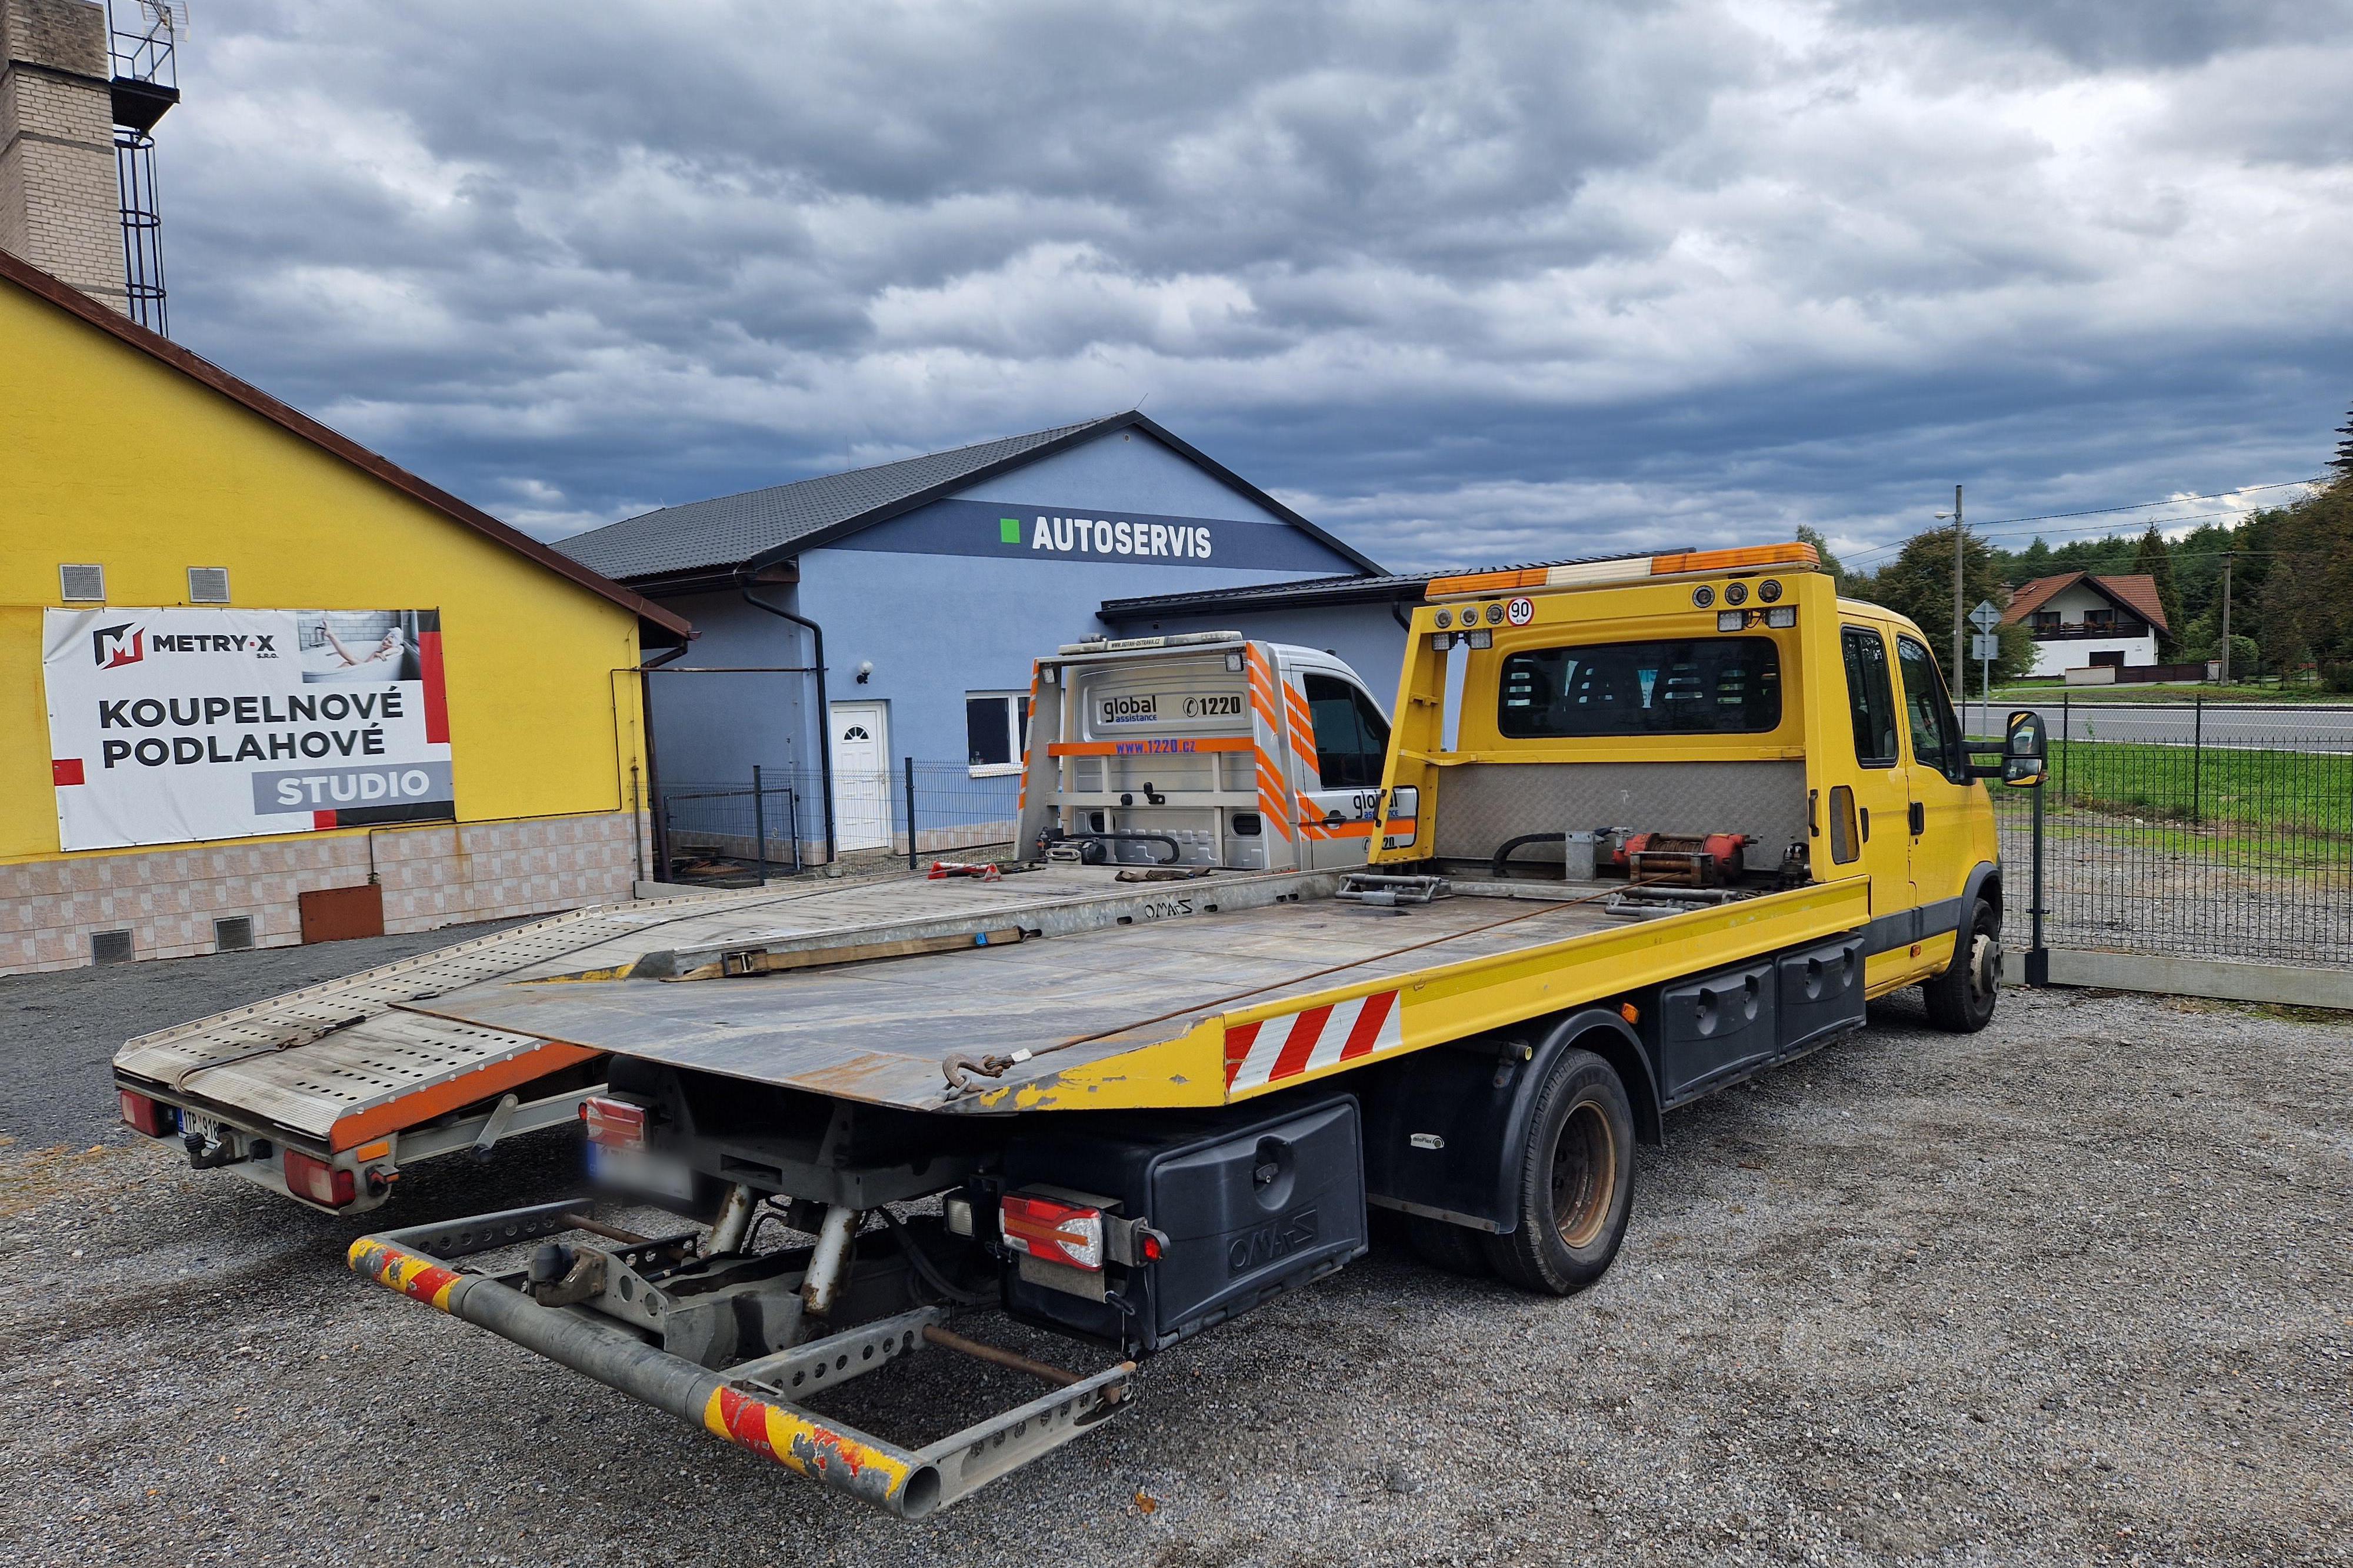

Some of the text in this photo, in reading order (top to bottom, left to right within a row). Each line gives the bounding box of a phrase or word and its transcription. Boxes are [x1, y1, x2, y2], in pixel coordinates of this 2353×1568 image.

[1032, 516, 1212, 559] AUTOSERVIS
[1511, 602, 1529, 618] 90
[99, 686, 404, 728] KOUPELNOVÉ
[1104, 695, 1156, 723] global
[1115, 714, 1157, 722] assistance
[1200, 696, 1241, 715] 1220
[102, 722, 385, 768] PODLAHOVÉ
[1116, 739, 1195, 753] www.1220.cz
[277, 770, 429, 805] STUDIO
[184, 1110, 220, 1142] 1TP 918
